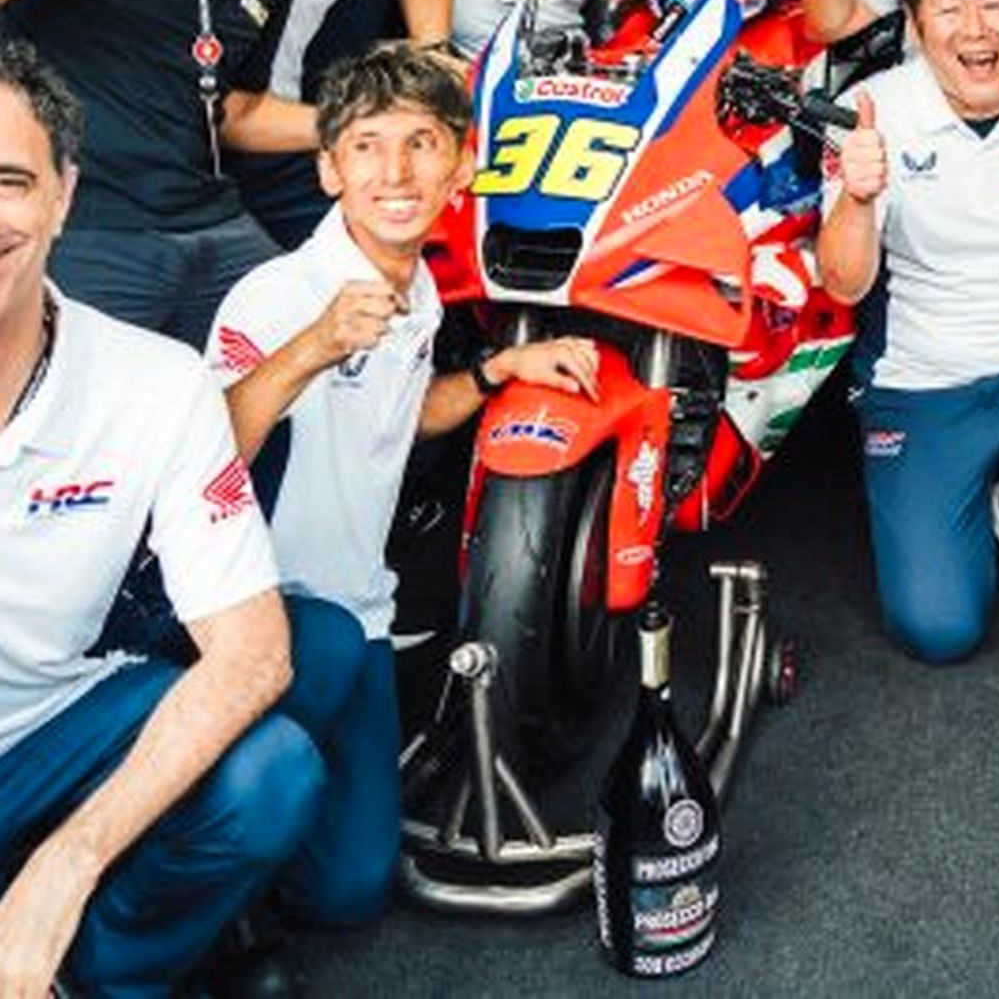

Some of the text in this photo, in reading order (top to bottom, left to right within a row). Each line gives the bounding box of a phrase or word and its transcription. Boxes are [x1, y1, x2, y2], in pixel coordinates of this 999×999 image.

[536, 81, 625, 103] Castrol
[471, 113, 642, 201] 36
[621, 169, 714, 222] HONDA
[28, 481, 114, 513] HRC
